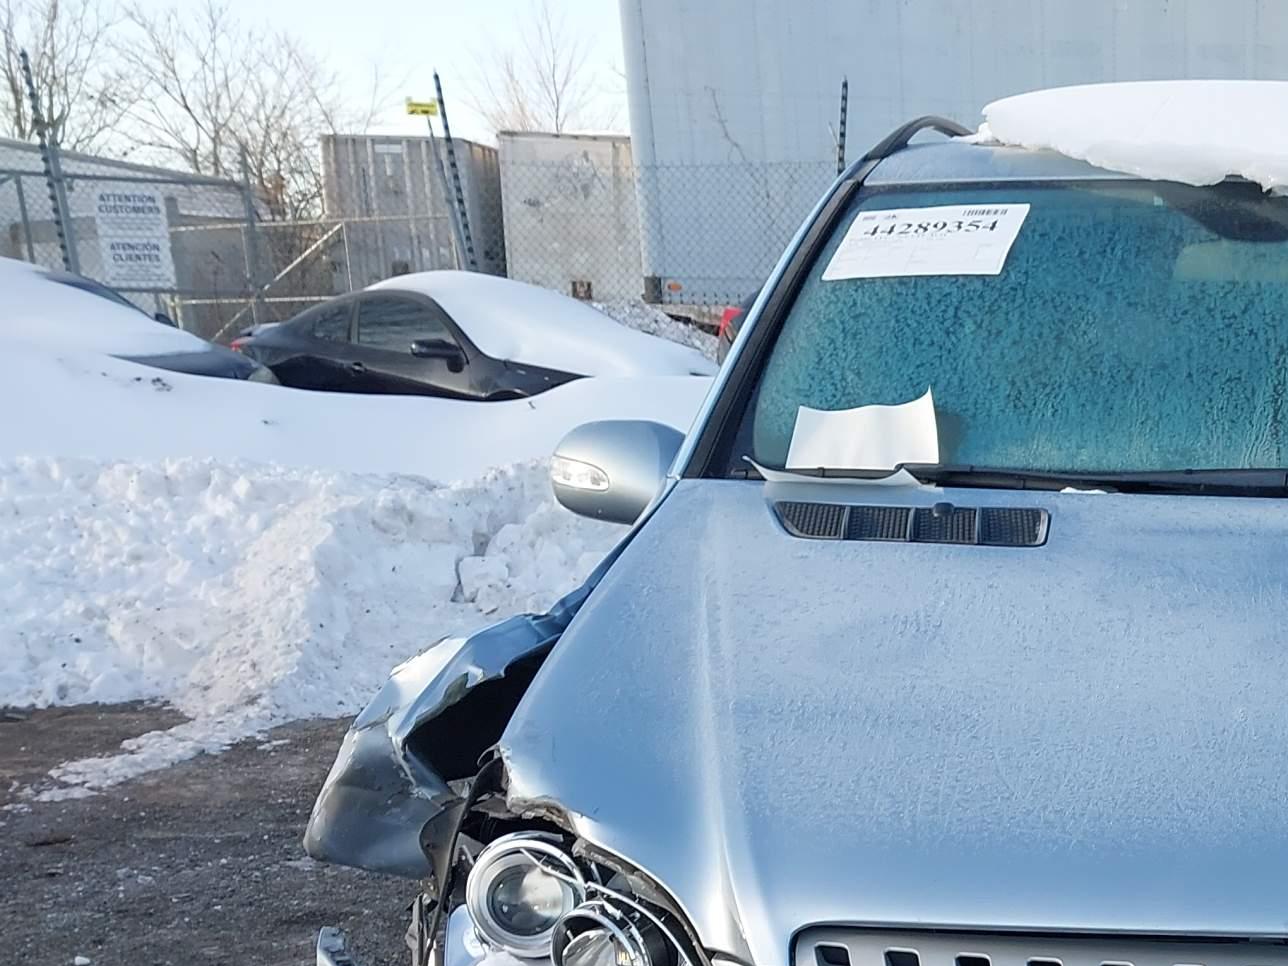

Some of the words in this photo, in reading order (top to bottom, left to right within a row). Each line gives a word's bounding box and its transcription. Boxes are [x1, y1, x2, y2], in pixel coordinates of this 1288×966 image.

[99, 193, 156, 204] ATTENTION
[98, 205, 161, 215] CUSTOMERS
[863, 219, 999, 237] 44289354
[112, 253, 161, 263] CLIENTES
